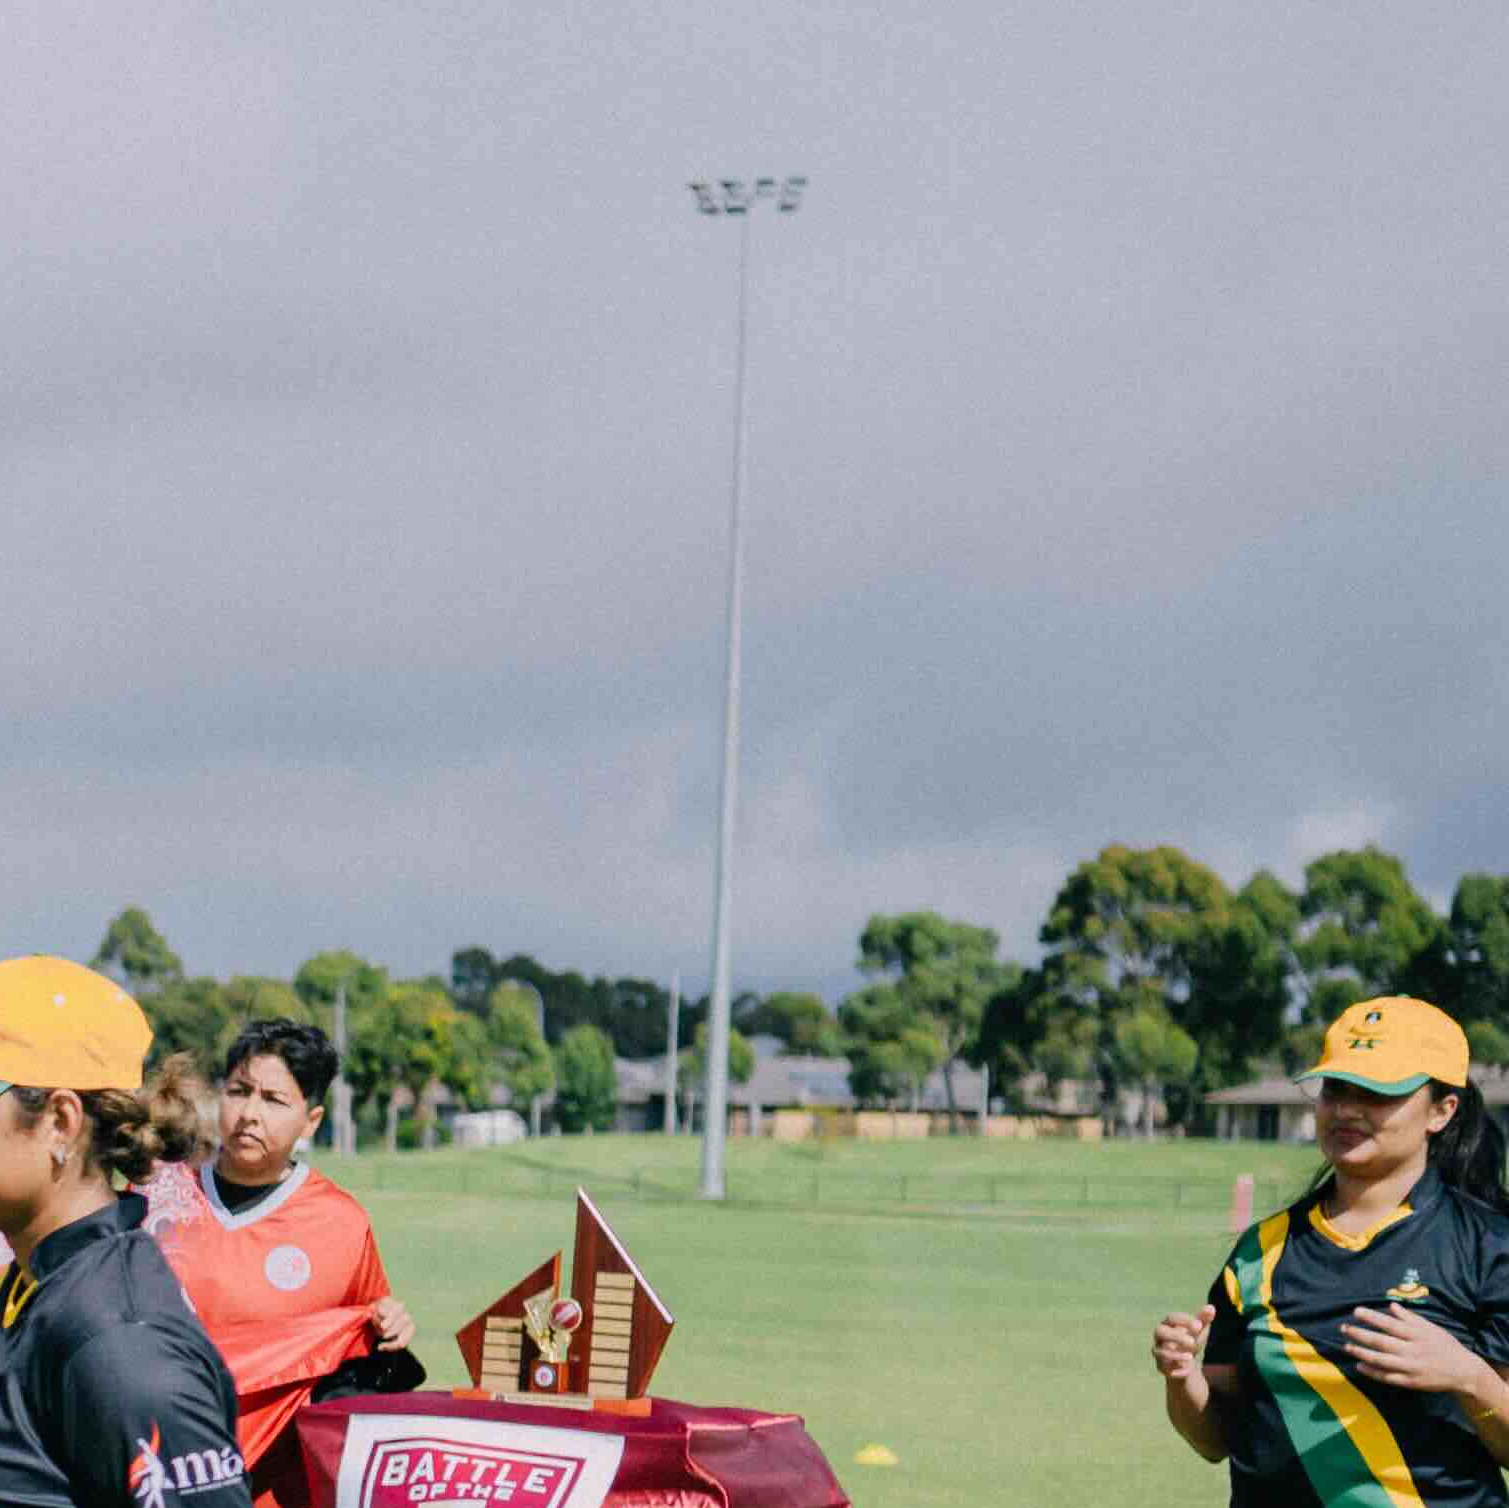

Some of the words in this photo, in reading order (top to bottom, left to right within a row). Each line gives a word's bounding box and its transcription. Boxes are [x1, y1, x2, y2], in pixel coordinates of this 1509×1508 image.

[381, 1452, 555, 1494] BATTLE
[408, 1483, 448, 1501] OF
[455, 1483, 516, 1501] THE
